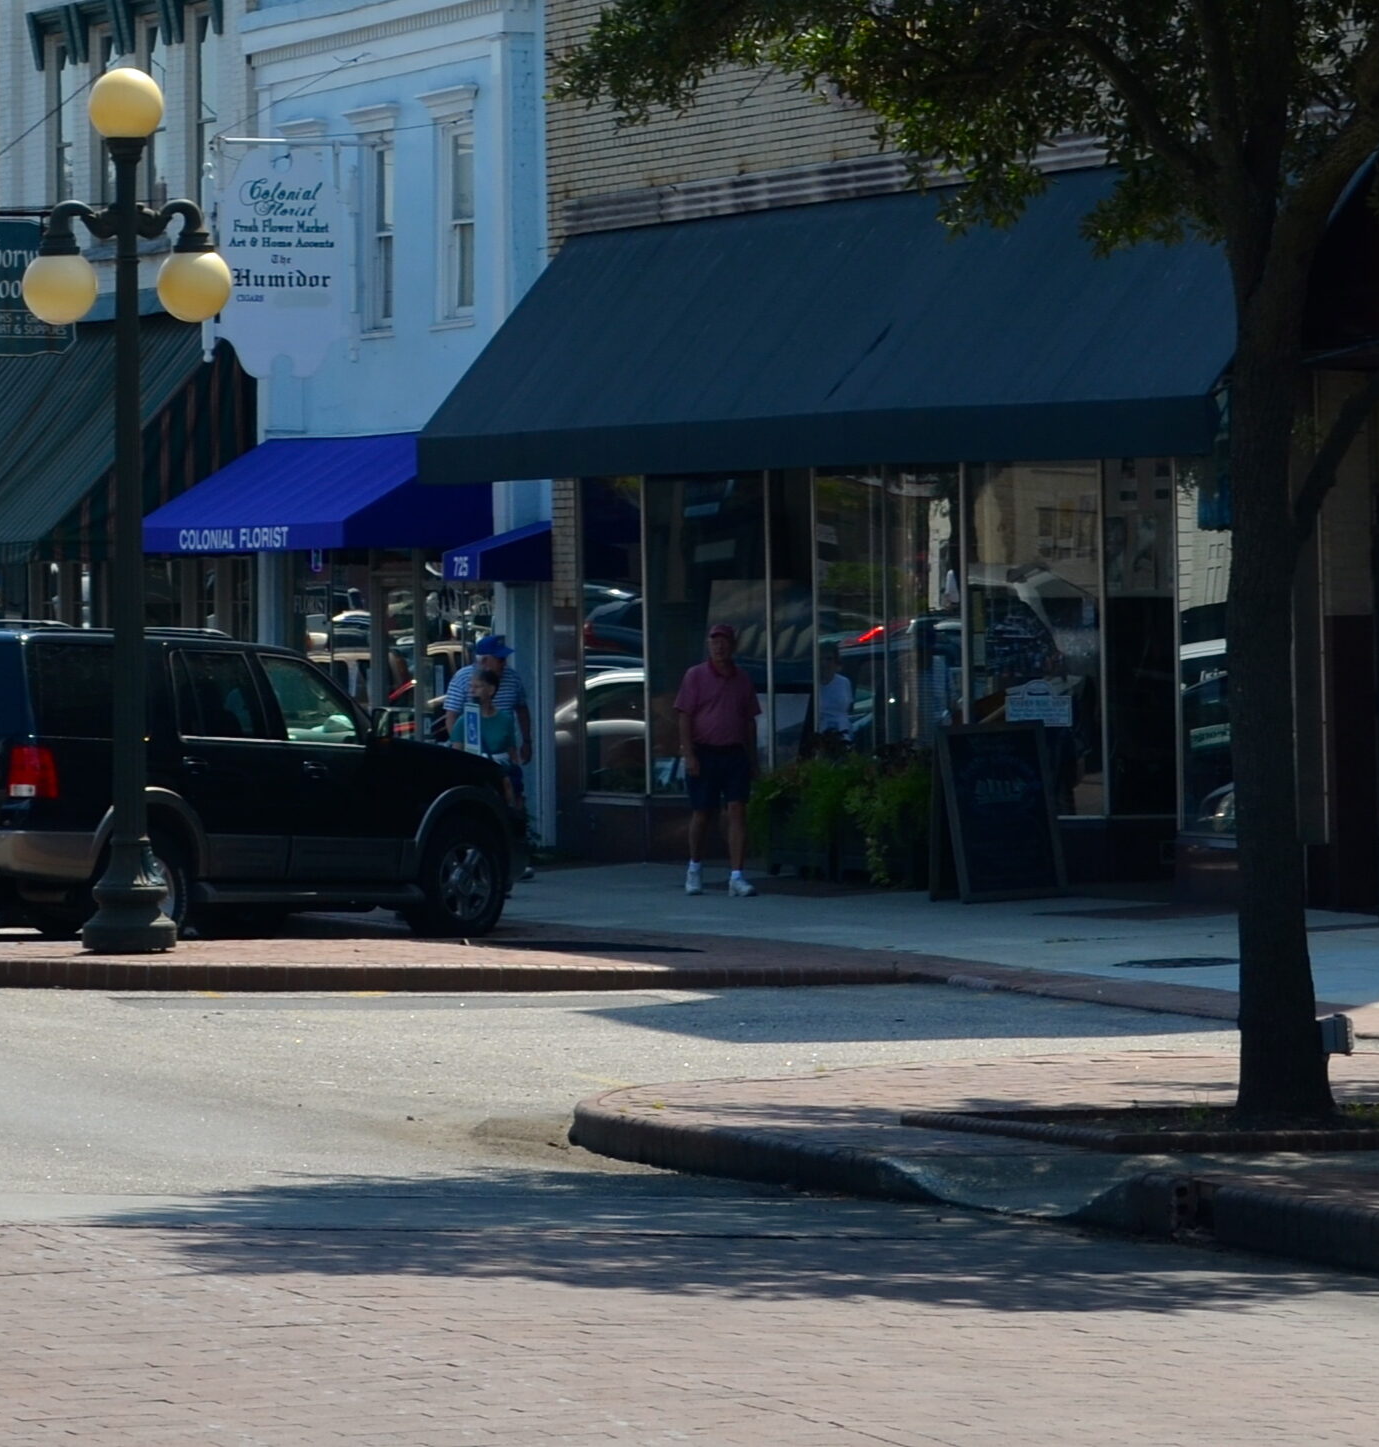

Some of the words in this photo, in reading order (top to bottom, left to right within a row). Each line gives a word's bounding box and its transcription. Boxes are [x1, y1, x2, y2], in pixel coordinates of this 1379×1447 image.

[239, 178, 323, 205] Colonial
[254, 201, 316, 216] Florist
[233, 218, 258, 233] Fresh
[262, 218, 293, 233] Flower
[296, 219, 329, 233] Market
[228, 237, 246, 248] Art
[249, 237, 258, 247] &
[262, 237, 292, 248] Home
[295, 237, 334, 248] Accents
[271, 254, 291, 264] The
[233, 268, 331, 288] Humidor
[179, 529, 236, 550] COLONIAL
[239, 526, 289, 548] FLORIST
[453, 555, 469, 577] 725
